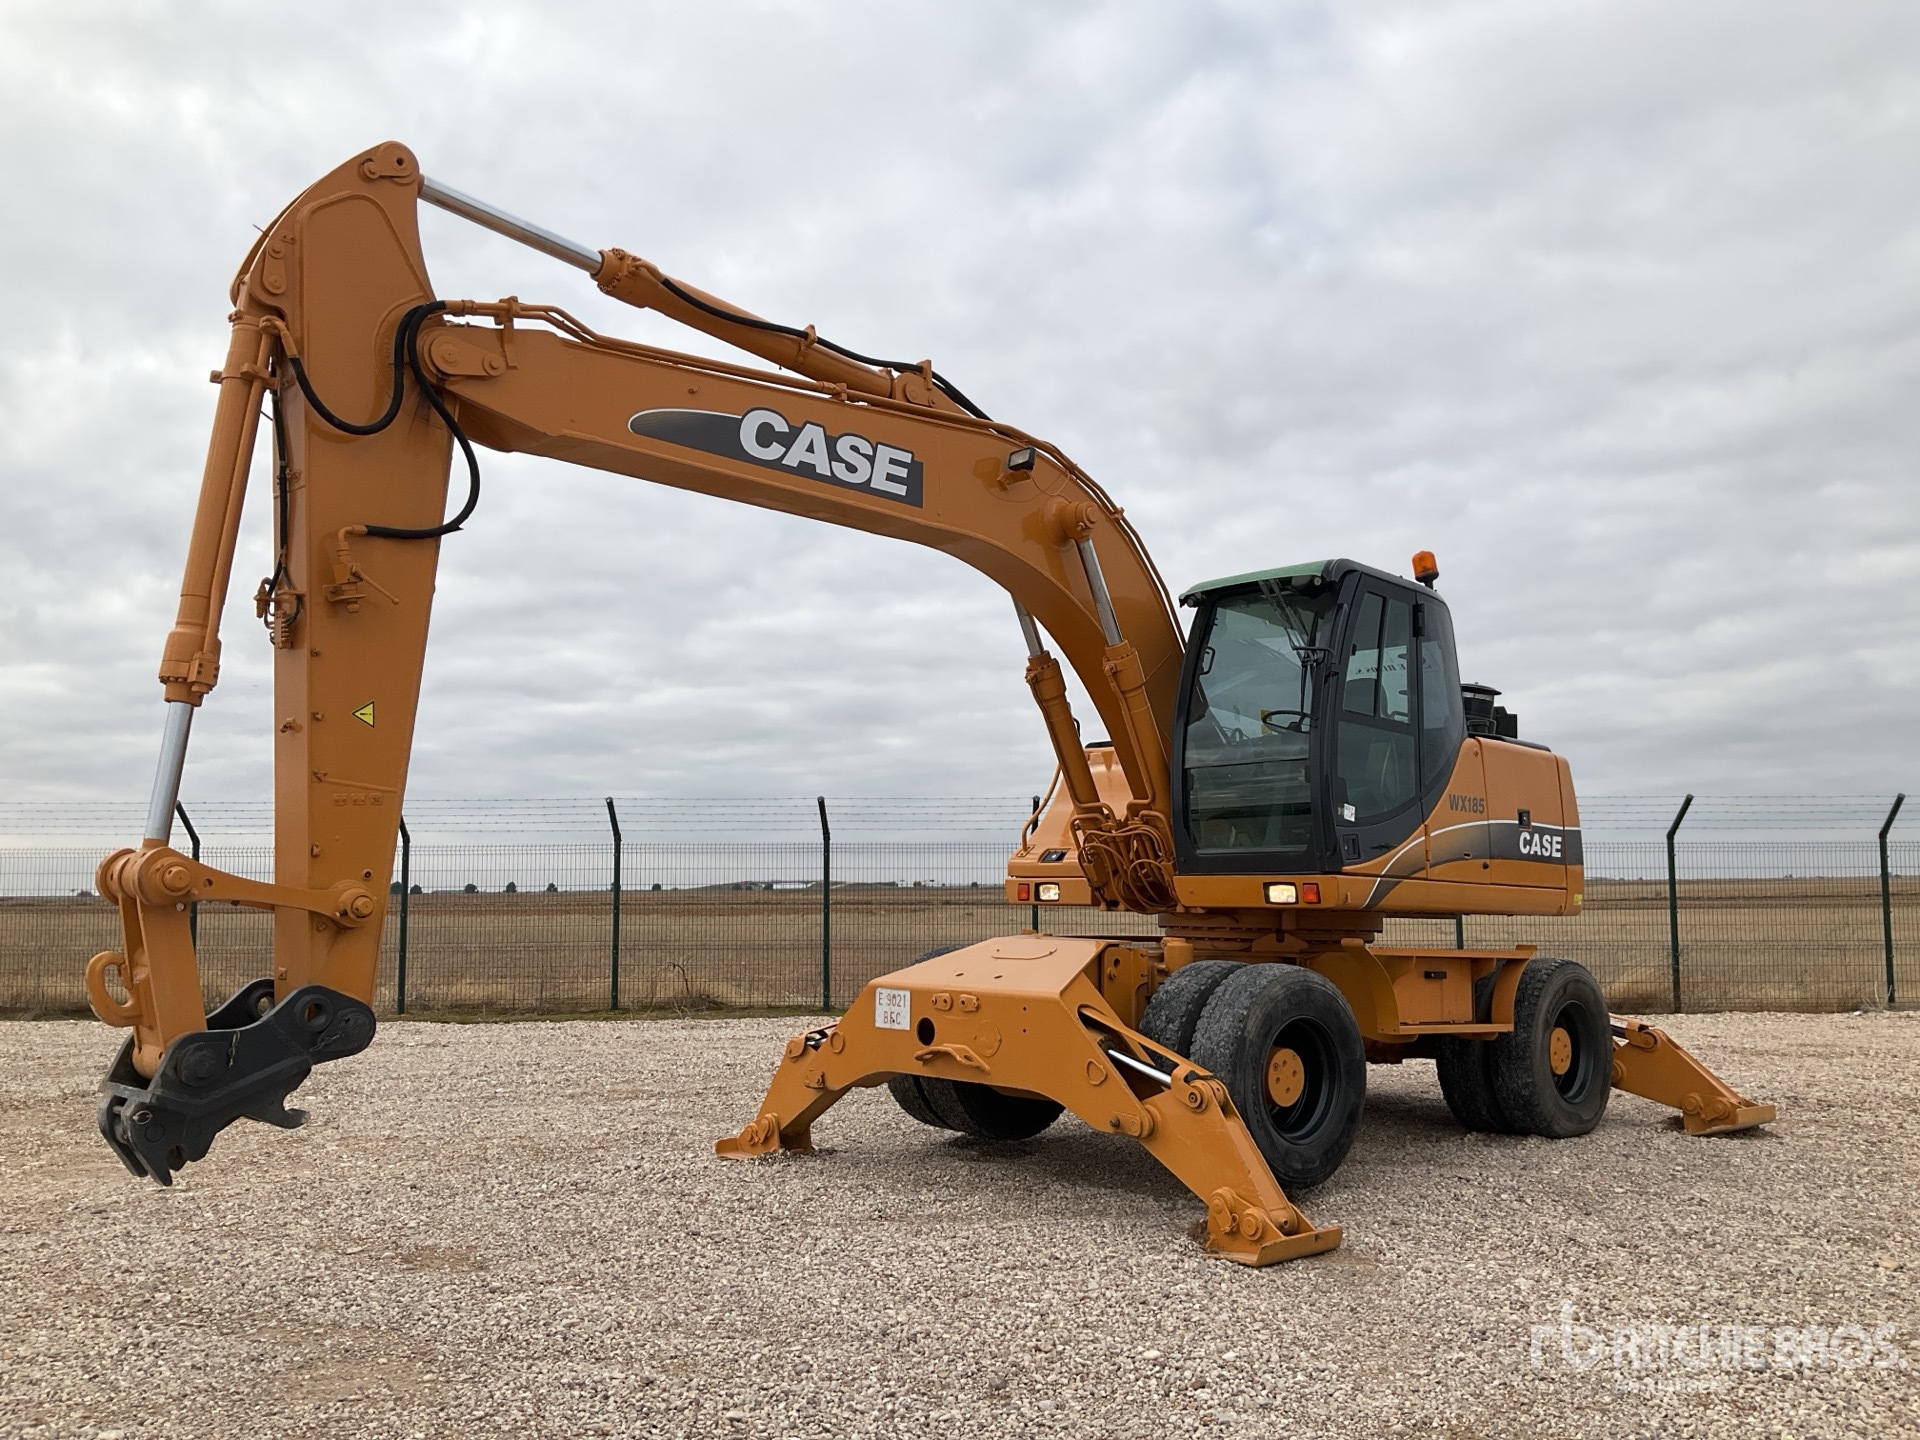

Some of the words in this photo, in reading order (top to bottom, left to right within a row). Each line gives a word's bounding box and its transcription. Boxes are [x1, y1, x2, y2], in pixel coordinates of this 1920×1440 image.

[740, 409, 913, 496] CASE
[1449, 794, 1485, 814] WX185
[1519, 831, 1562, 858] CASE
[878, 992, 884, 1006] E
[883, 1010, 901, 1025] BFC
